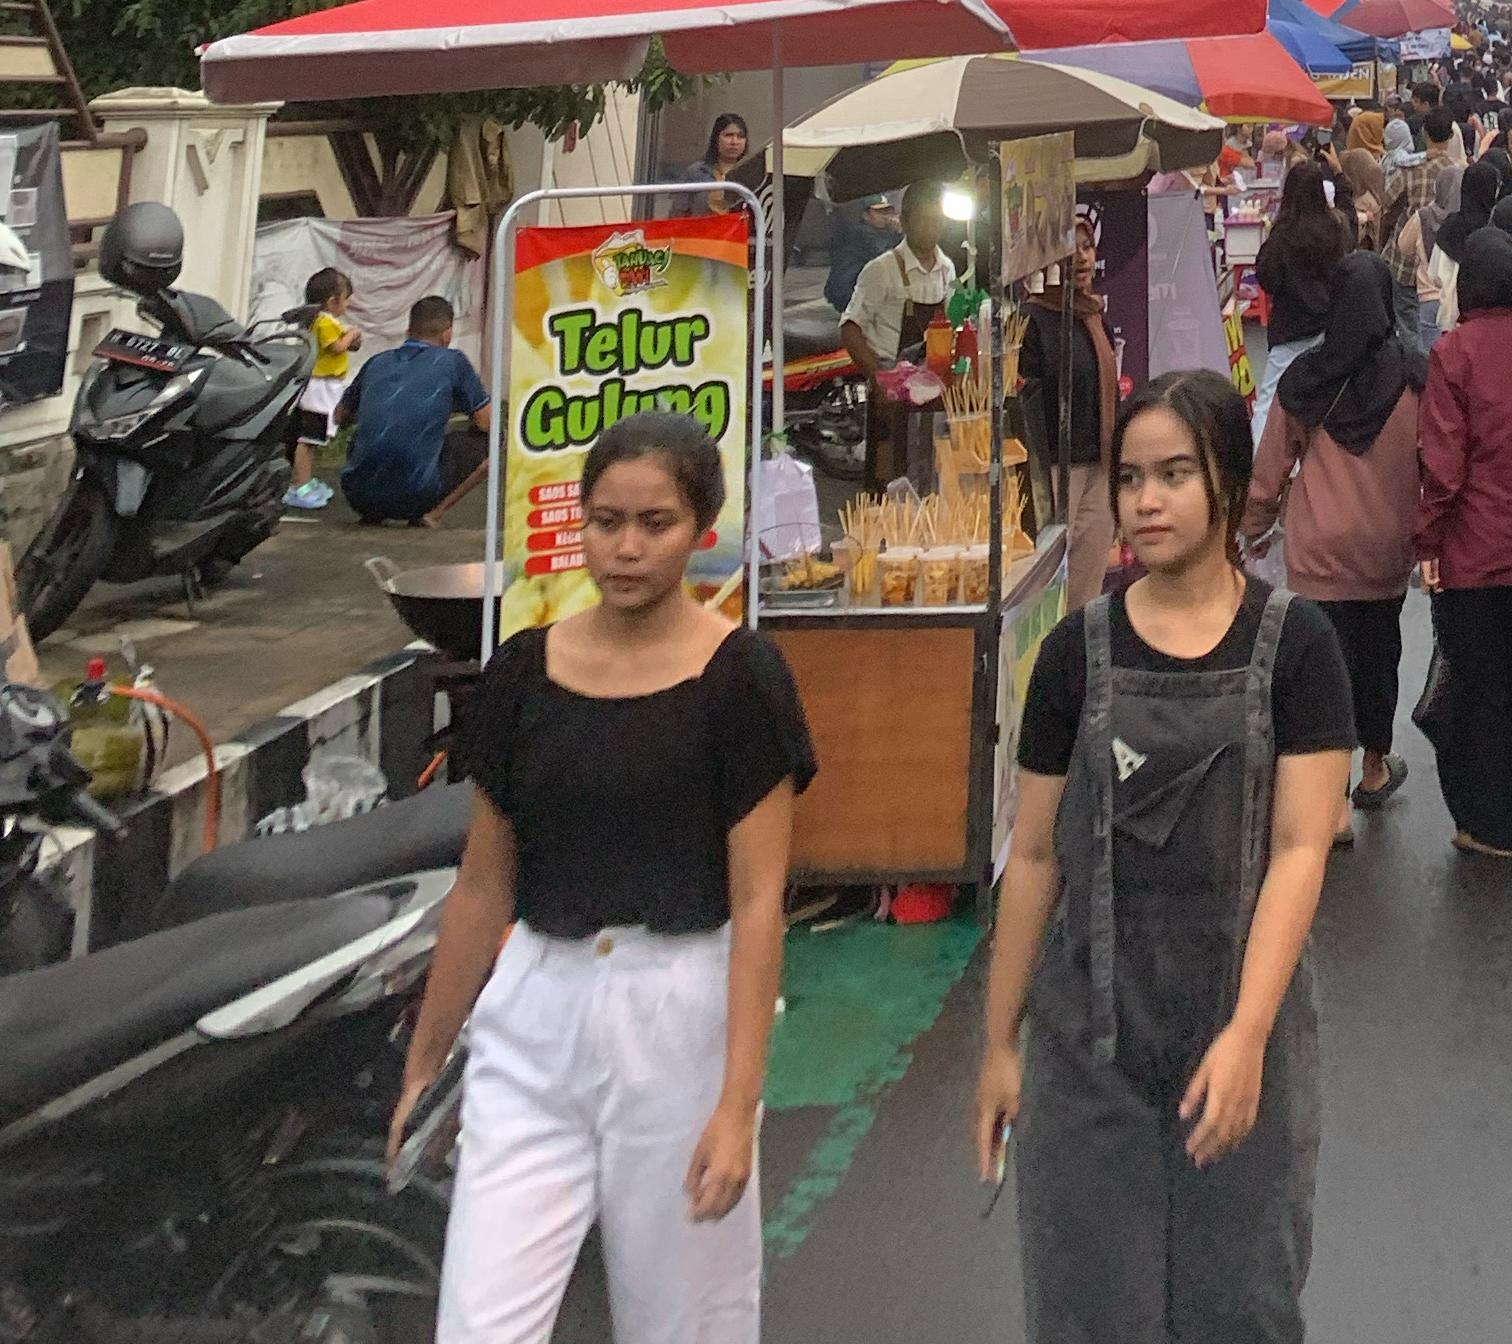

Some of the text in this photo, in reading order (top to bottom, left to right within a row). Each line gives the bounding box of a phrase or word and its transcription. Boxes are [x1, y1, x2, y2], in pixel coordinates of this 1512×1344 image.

[549, 308, 710, 376] Telur
[538, 485, 566, 502] SAOS
[541, 508, 569, 525] SAOS
